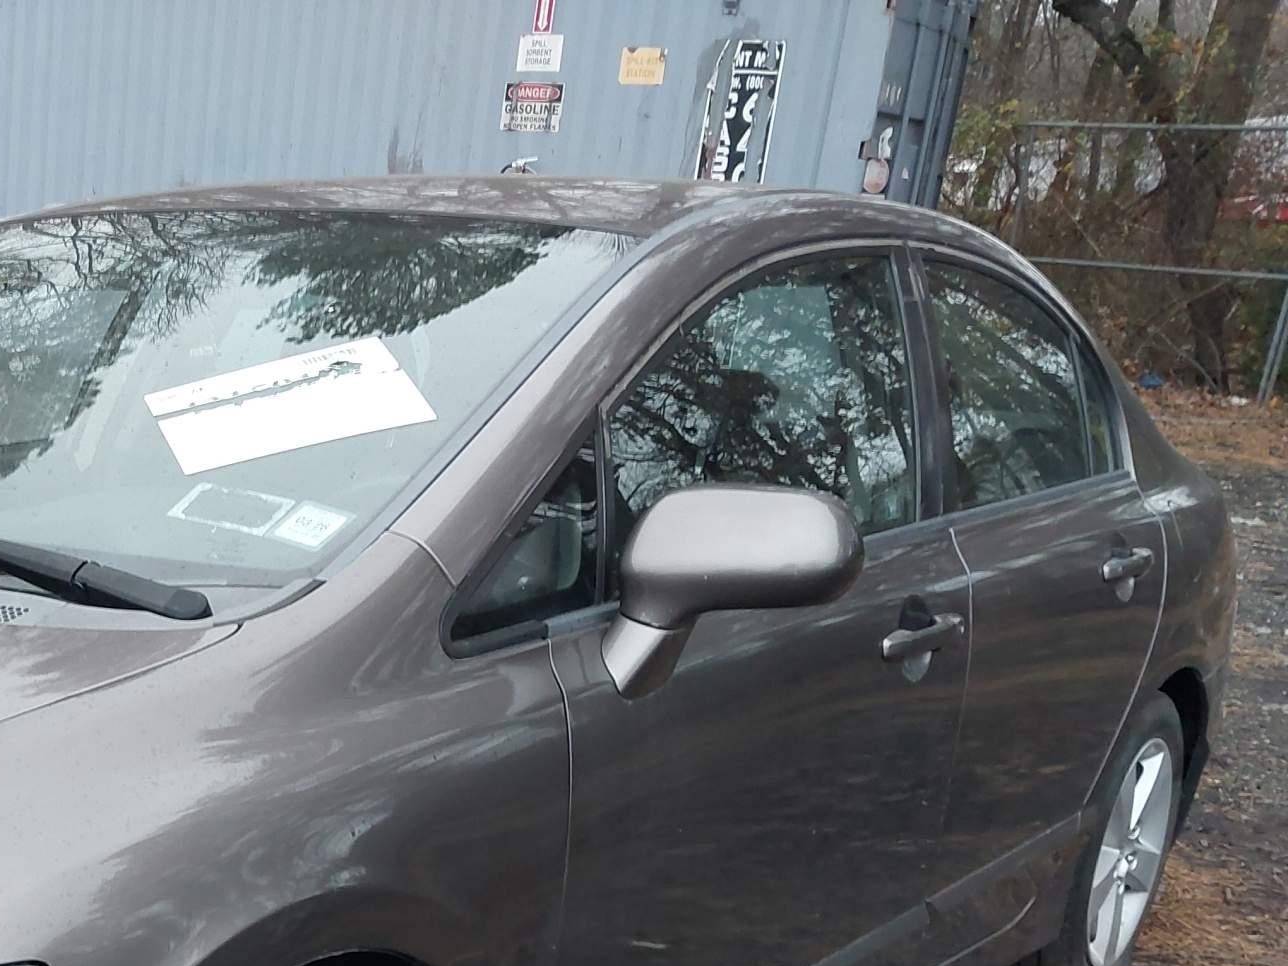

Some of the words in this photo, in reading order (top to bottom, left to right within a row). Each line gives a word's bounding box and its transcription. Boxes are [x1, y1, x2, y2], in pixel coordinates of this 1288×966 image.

[531, 39, 546, 47] SPILL
[526, 48, 552, 57] SORBENT
[524, 57, 551, 65] STORAGE
[504, 103, 560, 116] GASOLINE
[520, 116, 548, 124] SMOKIN
